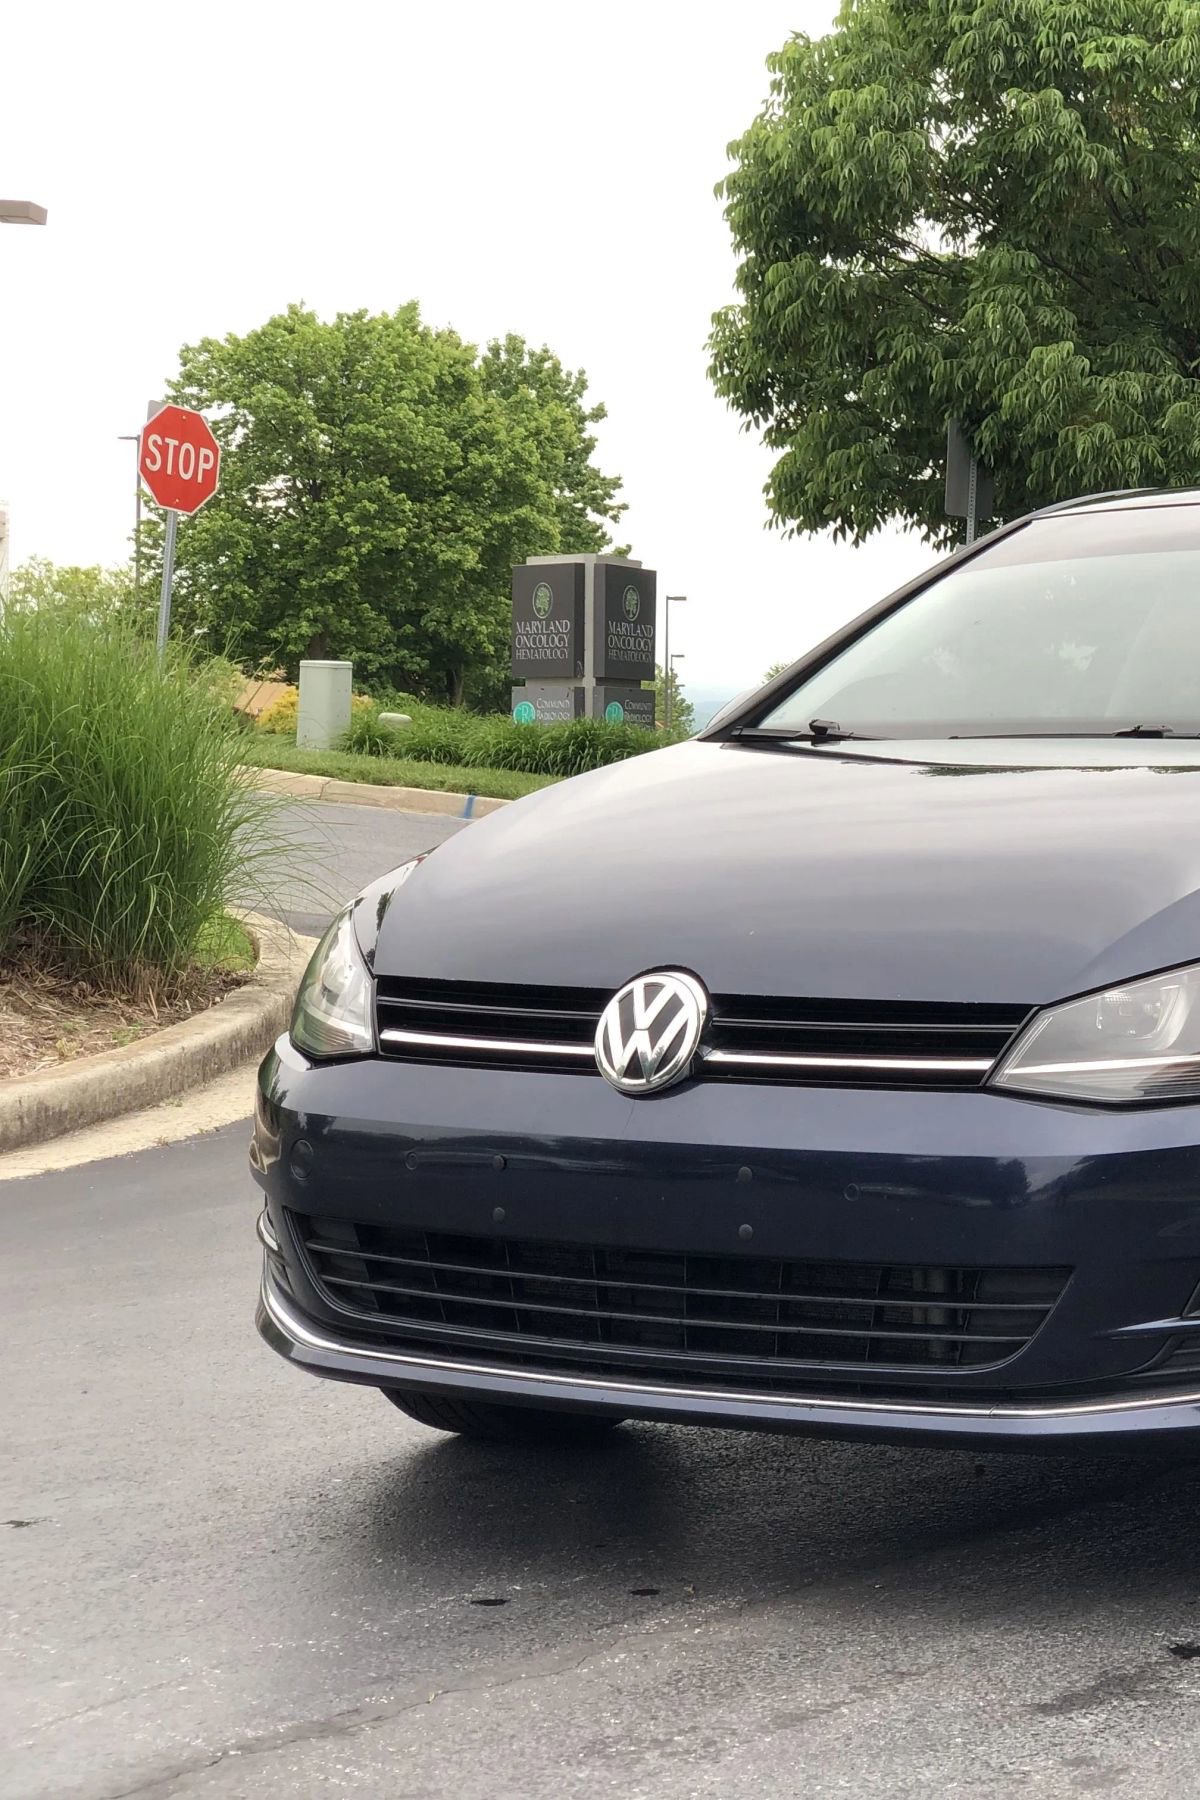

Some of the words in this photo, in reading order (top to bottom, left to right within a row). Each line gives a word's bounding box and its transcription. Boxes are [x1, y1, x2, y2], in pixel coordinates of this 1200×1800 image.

[145, 433, 215, 484] STOP
[516, 619, 570, 634] MARYLAND
[608, 620, 654, 638] MARYLAND
[515, 634, 570, 649] ONCOLOGY
[607, 634, 653, 652] ONCOLOGY
[515, 648, 569, 660] HEMATOLOGY
[608, 648, 653, 663] HEMATOLOGY
